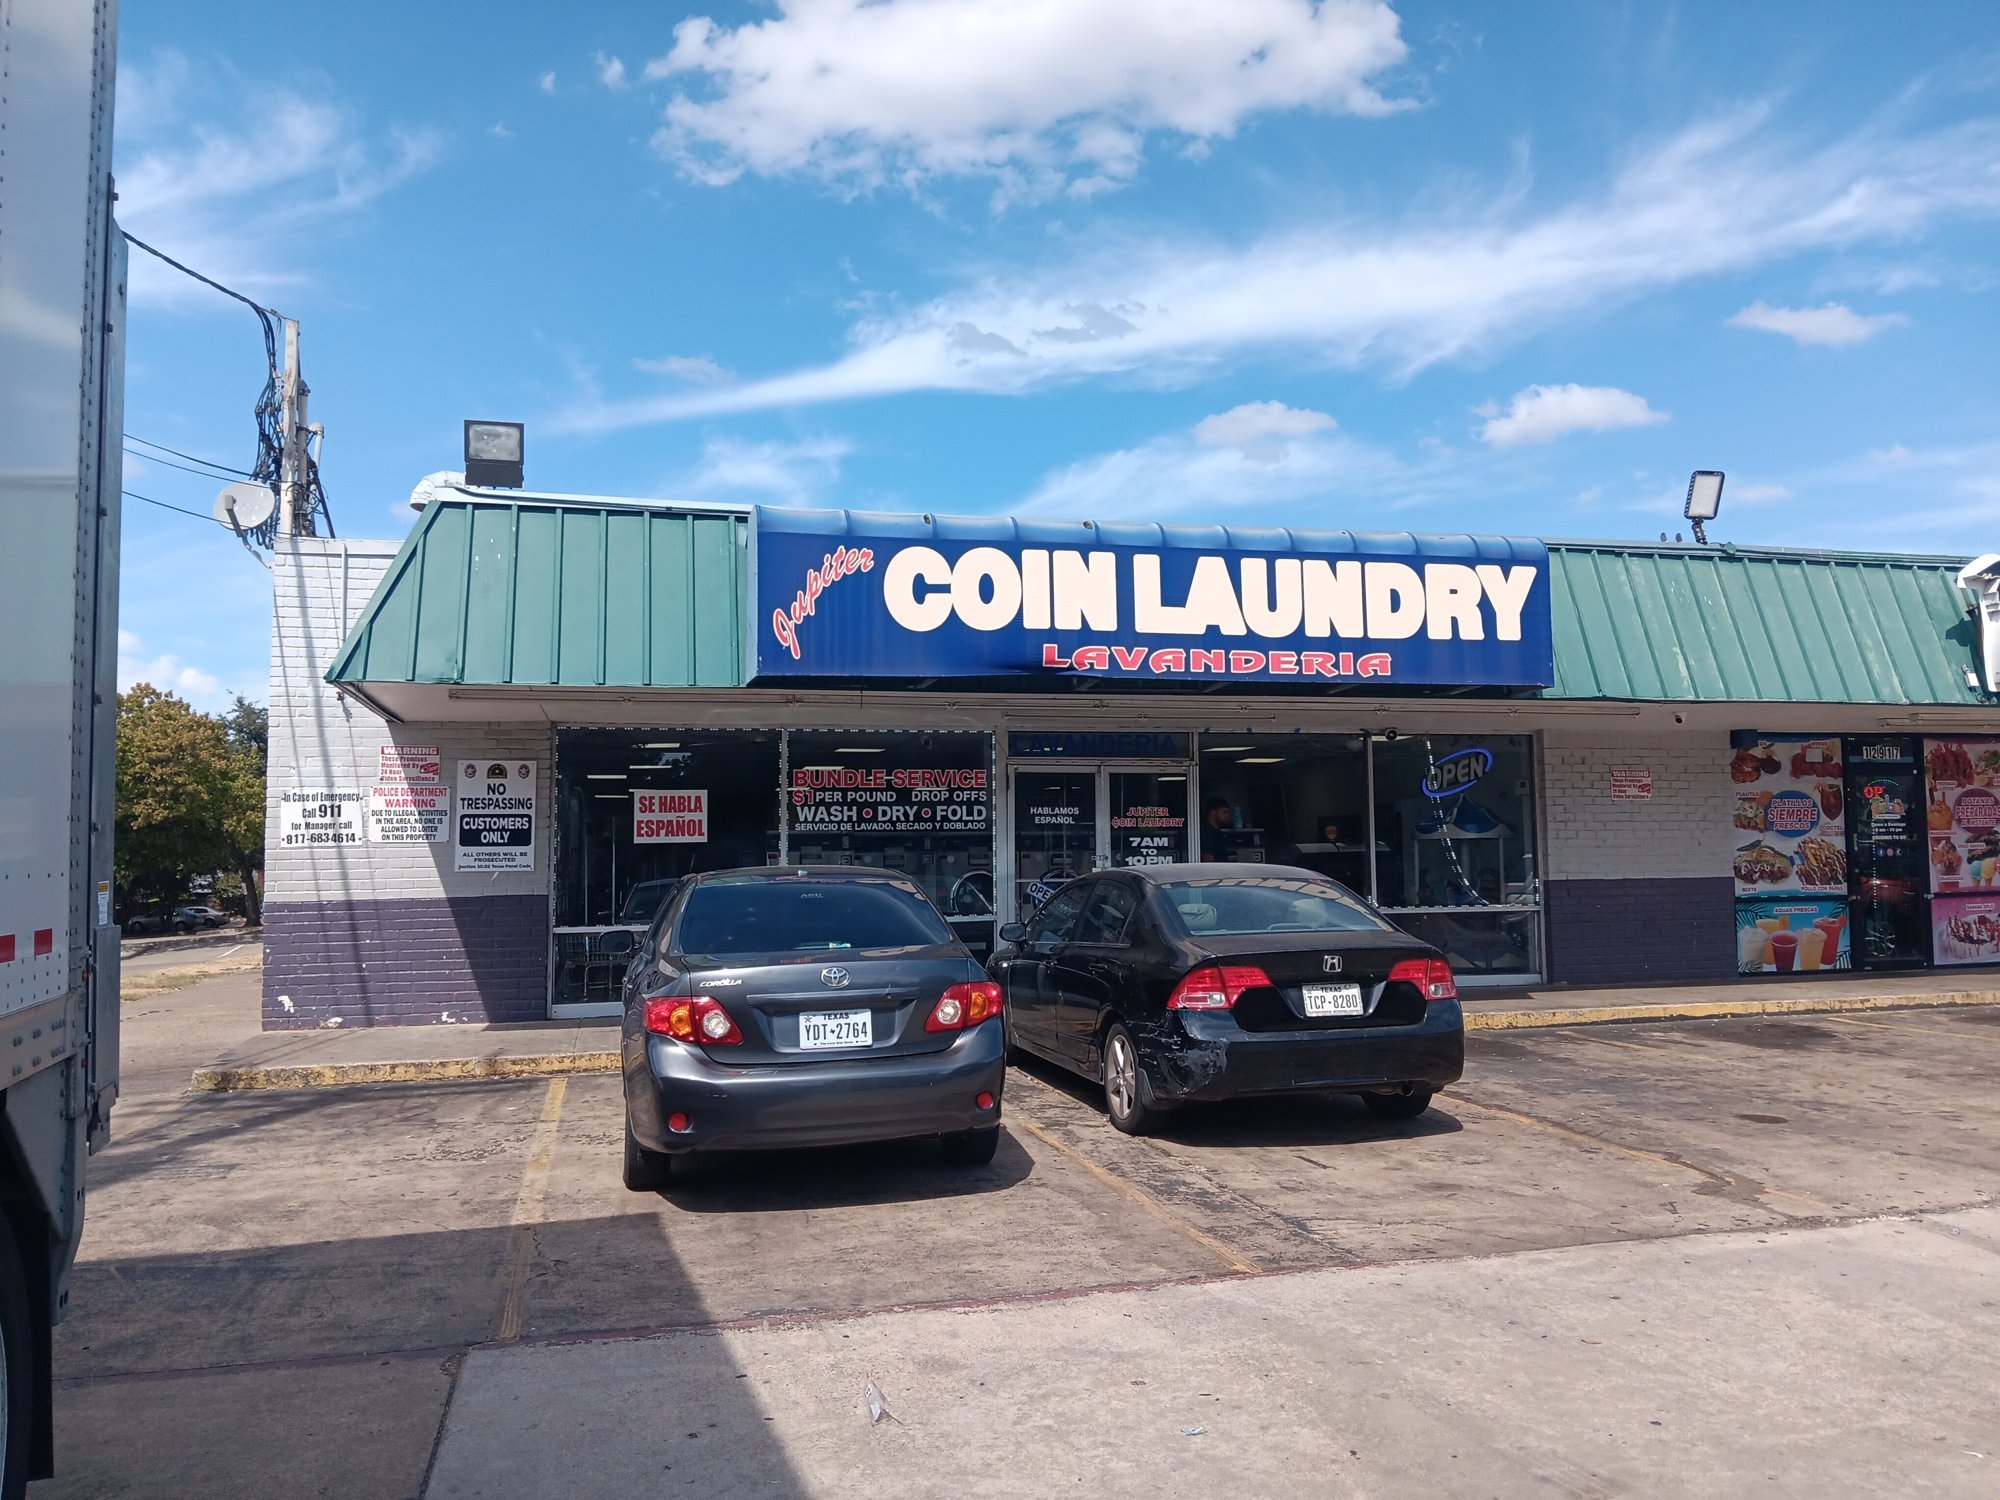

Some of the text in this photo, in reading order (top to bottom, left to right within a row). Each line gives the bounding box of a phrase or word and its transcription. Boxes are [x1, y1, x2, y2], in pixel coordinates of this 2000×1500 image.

[883, 546, 1538, 641] COIN LAUNDRY
[773, 545, 874, 660] Jupiter
[1041, 643, 1392, 678] LAVANDERIA
[383, 747, 437, 755] WARNING
[1863, 746, 1900, 760] 12917
[793, 769, 987, 788] BUNDLE SERVICE
[1427, 755, 1483, 791] OPEN
[373, 788, 447, 797] POLICE DEPARTMENT
[487, 783, 507, 796] NO
[283, 792, 360, 802] In Case of Emergency
[385, 799, 436, 808] WARNING
[460, 797, 533, 810] TRESPASSING
[792, 789, 987, 805] $1 PER POUND DROP OFFS
[302, 804, 342, 818] Call 911
[639, 796, 703, 813] SE HABLA
[1030, 807, 1079, 815] HABLAMOS
[1126, 806, 1169, 816] JUPITER
[797, 805, 986, 822] WASH DRY FOLD
[1034, 815, 1075, 824] ESPAÑOL
[1768, 808, 1817, 820] SIEMPRE
[291, 821, 352, 830] for Manager call
[462, 817, 529, 829] CUSTOMERS
[636, 816, 705, 837] ESPAÑOL
[855, 822, 894, 830] LAVADO,
[896, 822, 932, 830] SECADO
[1138, 818, 1185, 827] LAUNDRY
[480, 831, 510, 844] ONLY
[1129, 837, 1168, 847] 7AM
[1030, 883, 1054, 899] OPE
[699, 978, 742, 987] COROLLA
[1308, 994, 1358, 1009] TCP 8280
[823, 1012, 849, 1020] TEXAS
[805, 1022, 867, 1040] YDT 2764
